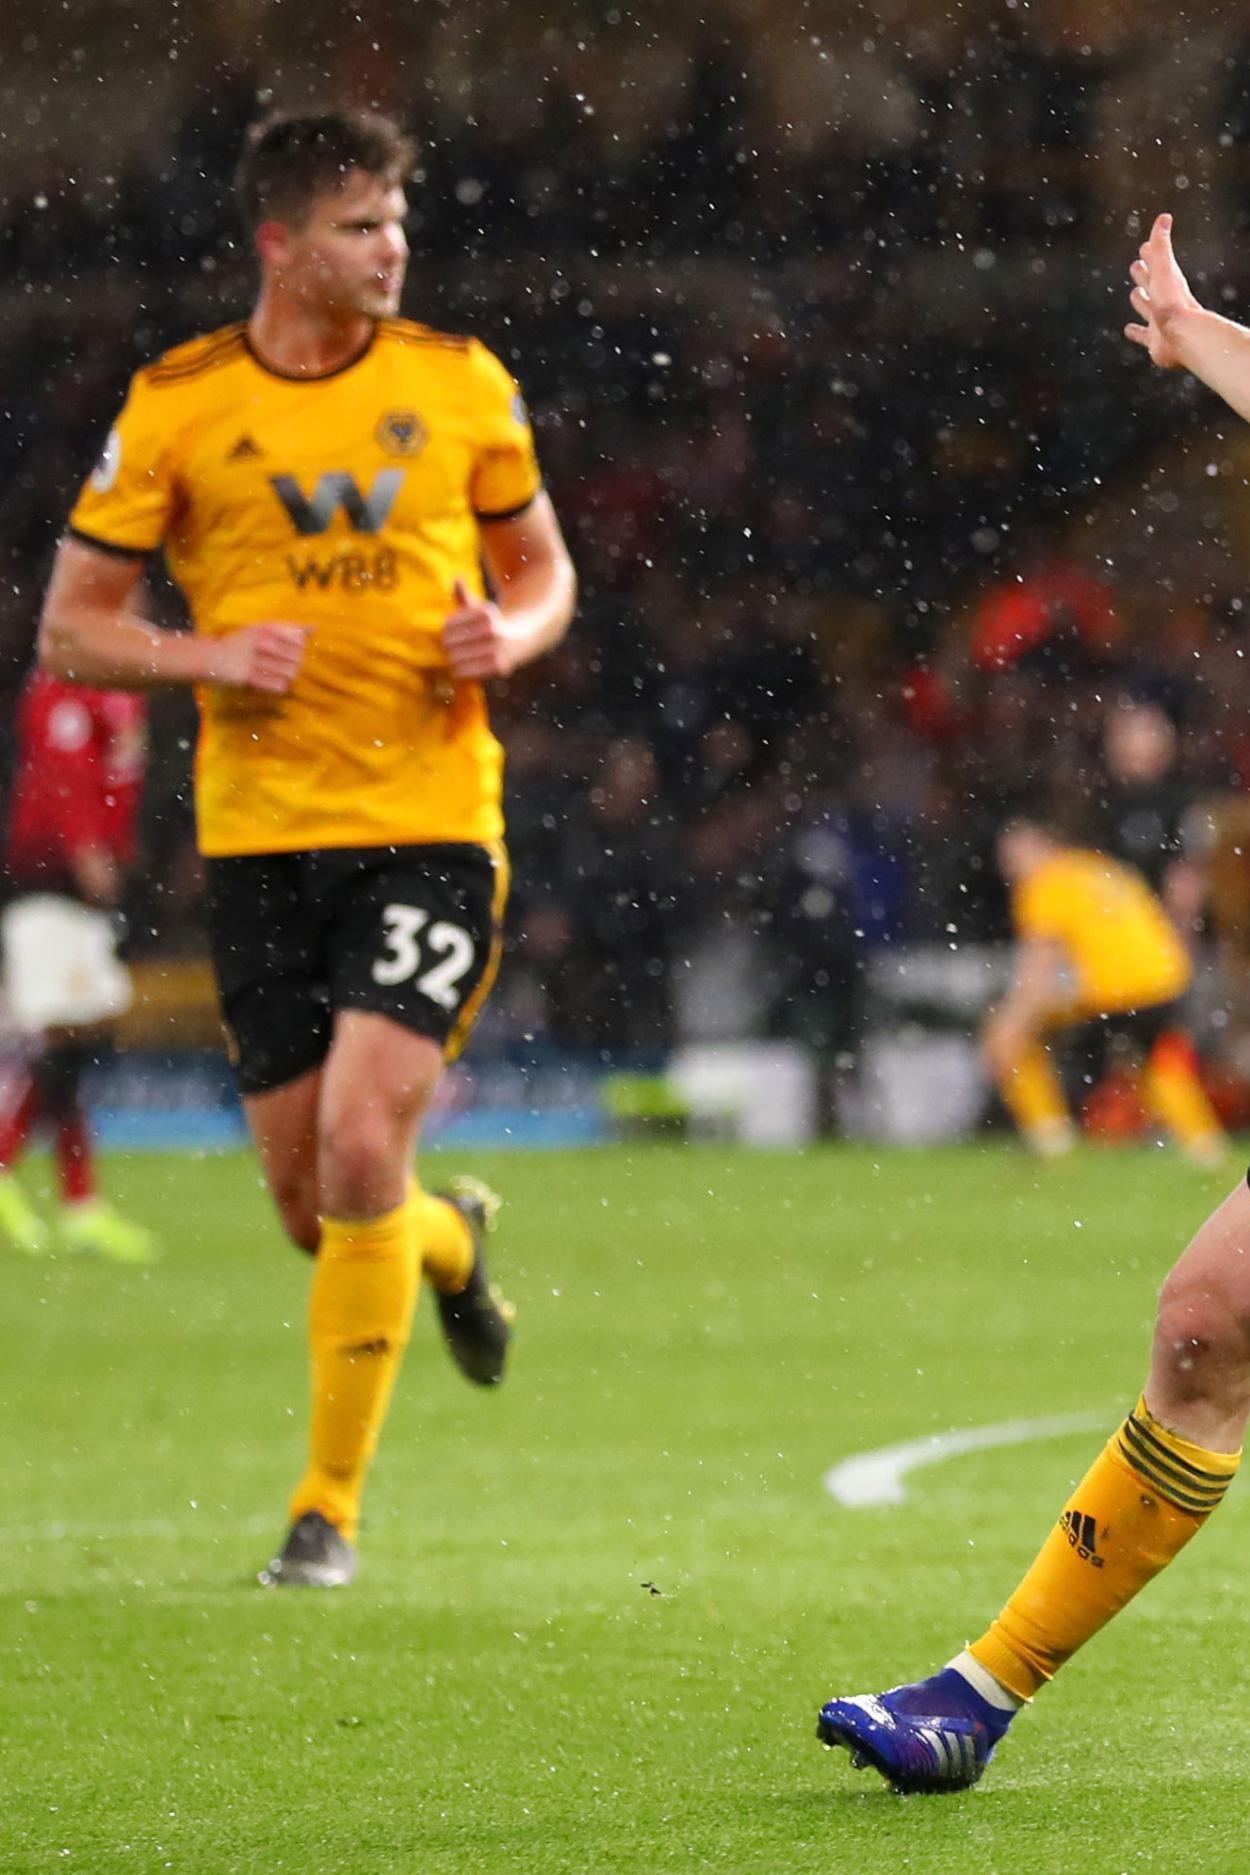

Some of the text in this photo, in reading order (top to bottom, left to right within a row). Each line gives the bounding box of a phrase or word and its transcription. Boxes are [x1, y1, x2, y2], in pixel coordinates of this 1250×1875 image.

[268, 468, 406, 534] W
[286, 549, 399, 591] W88
[371, 903, 475, 1012] 32
